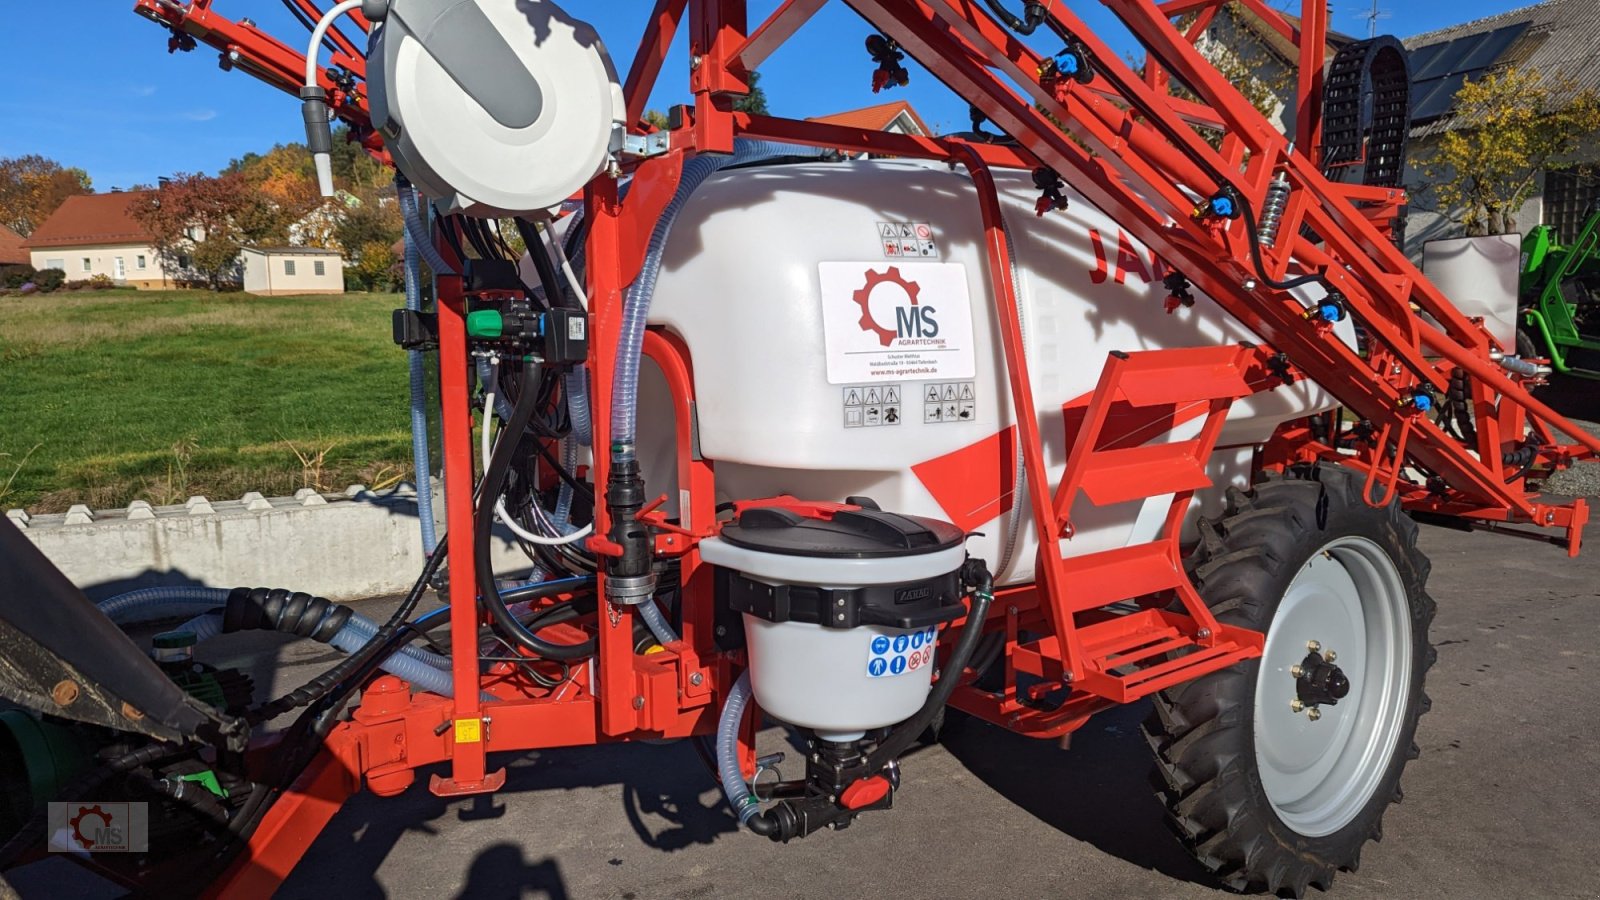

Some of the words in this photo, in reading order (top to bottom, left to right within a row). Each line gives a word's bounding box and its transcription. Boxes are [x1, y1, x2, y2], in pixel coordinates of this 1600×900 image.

[895, 305, 939, 338] MS
[898, 338, 946, 346] AGRARTECHNIK
[871, 367, 938, 376] www.ms-agrartechnik.de
